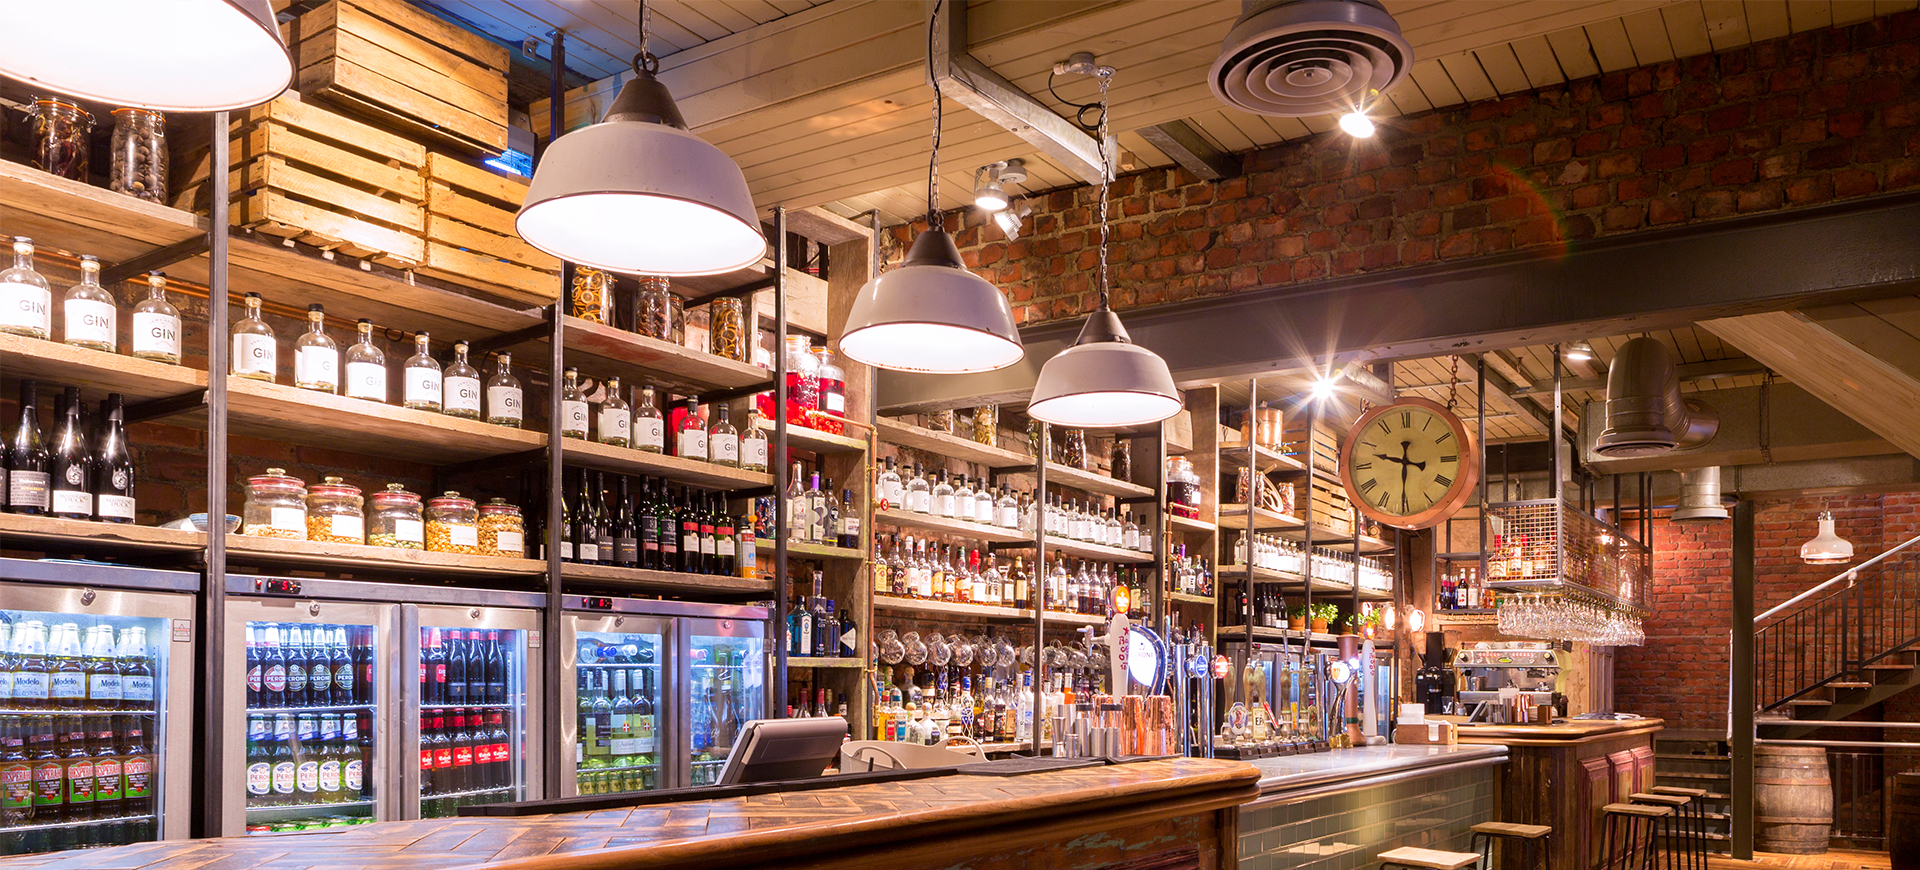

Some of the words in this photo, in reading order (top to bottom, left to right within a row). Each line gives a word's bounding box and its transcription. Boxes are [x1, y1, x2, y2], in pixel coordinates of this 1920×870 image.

[19, 299, 46, 315] GIN
[83, 314, 109, 329] GIN
[151, 327, 176, 341] GIN
[253, 347, 273, 361] GIN
[422, 379, 440, 392] GIN
[460, 388, 477, 400] GIN
[505, 397, 520, 409] GIN
[574, 411, 588, 422] GIN
[16, 677, 40, 685] Modelo
[53, 677, 77, 685] Modelo
